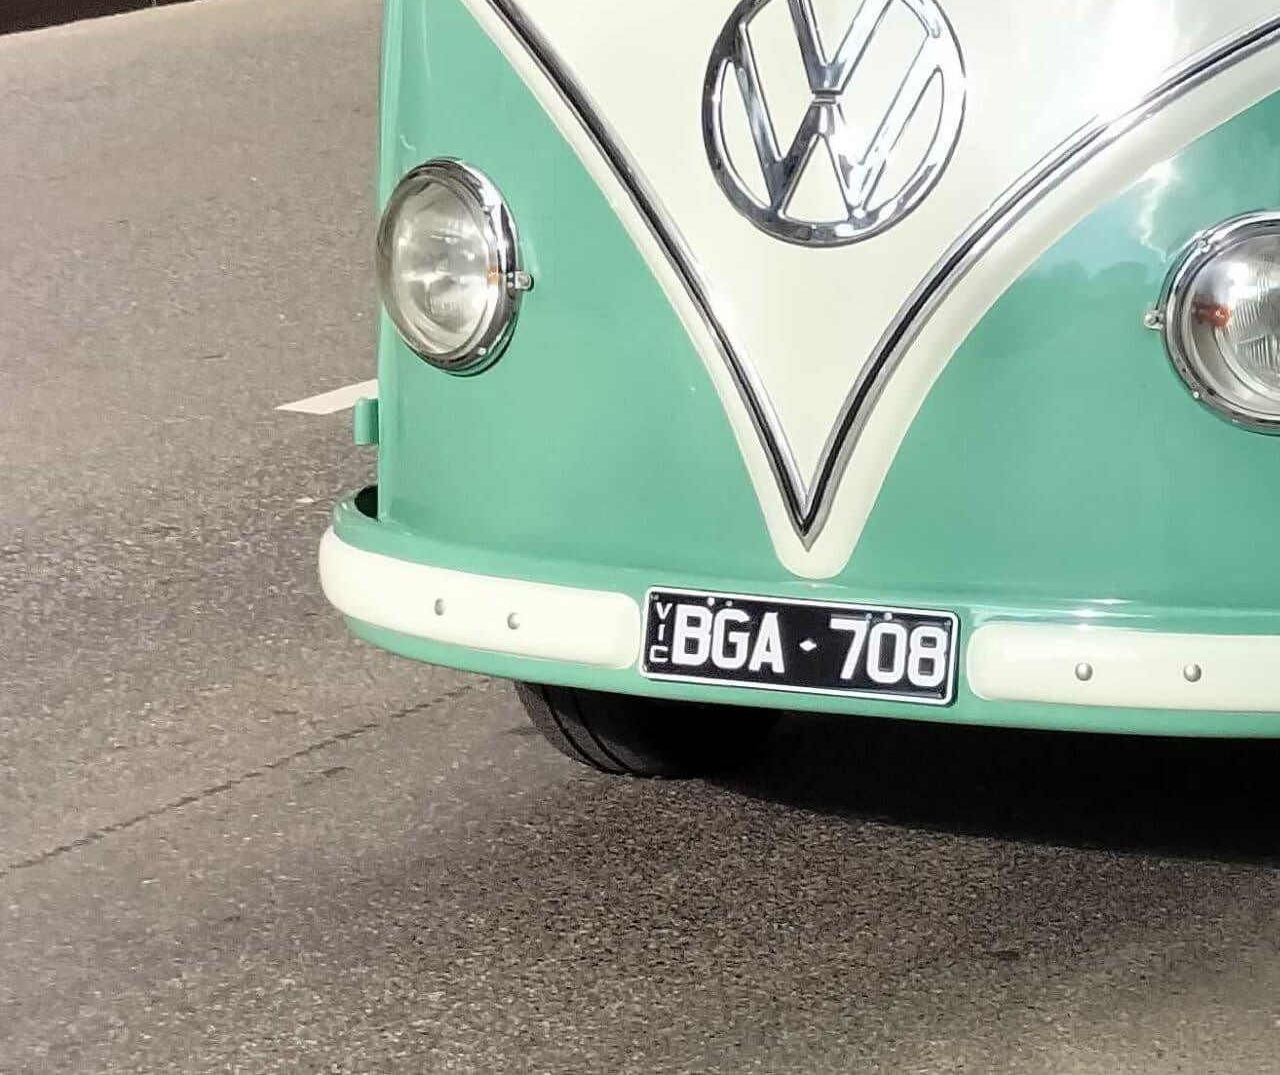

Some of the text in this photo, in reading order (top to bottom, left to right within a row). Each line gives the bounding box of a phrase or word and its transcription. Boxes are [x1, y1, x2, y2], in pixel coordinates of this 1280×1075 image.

[649, 601, 673, 664] VIC
[671, 603, 948, 687] BGA 708
